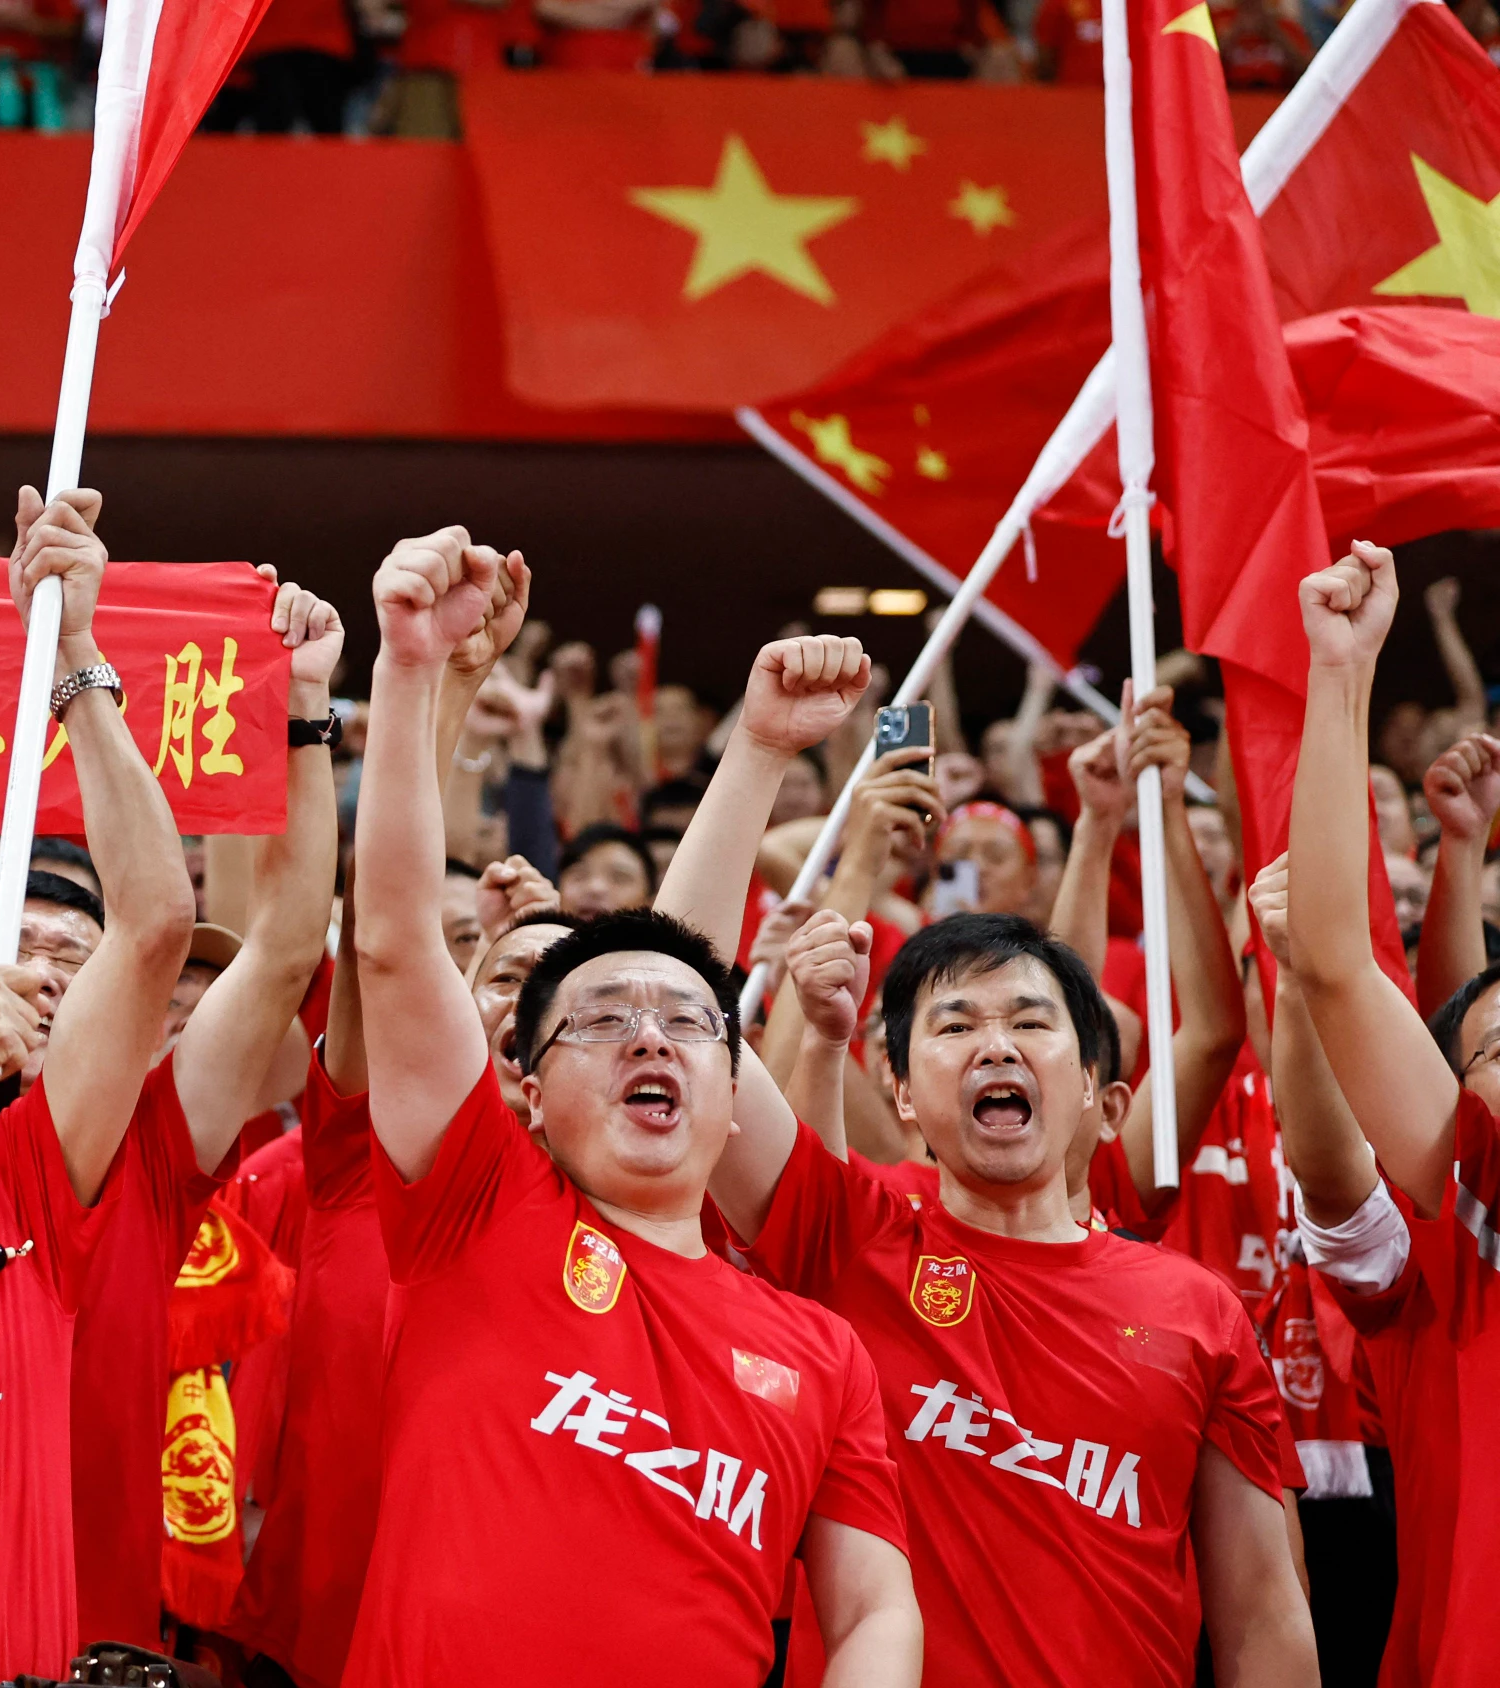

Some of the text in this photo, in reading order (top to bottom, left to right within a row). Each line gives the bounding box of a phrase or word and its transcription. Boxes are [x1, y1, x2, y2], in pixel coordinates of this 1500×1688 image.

[581, 1234, 620, 1265] 龙之队
[928, 1261, 968, 1277] 龙之队
[530, 1370, 769, 1551] 龙之队
[904, 1379, 1142, 1529] 龙之队
